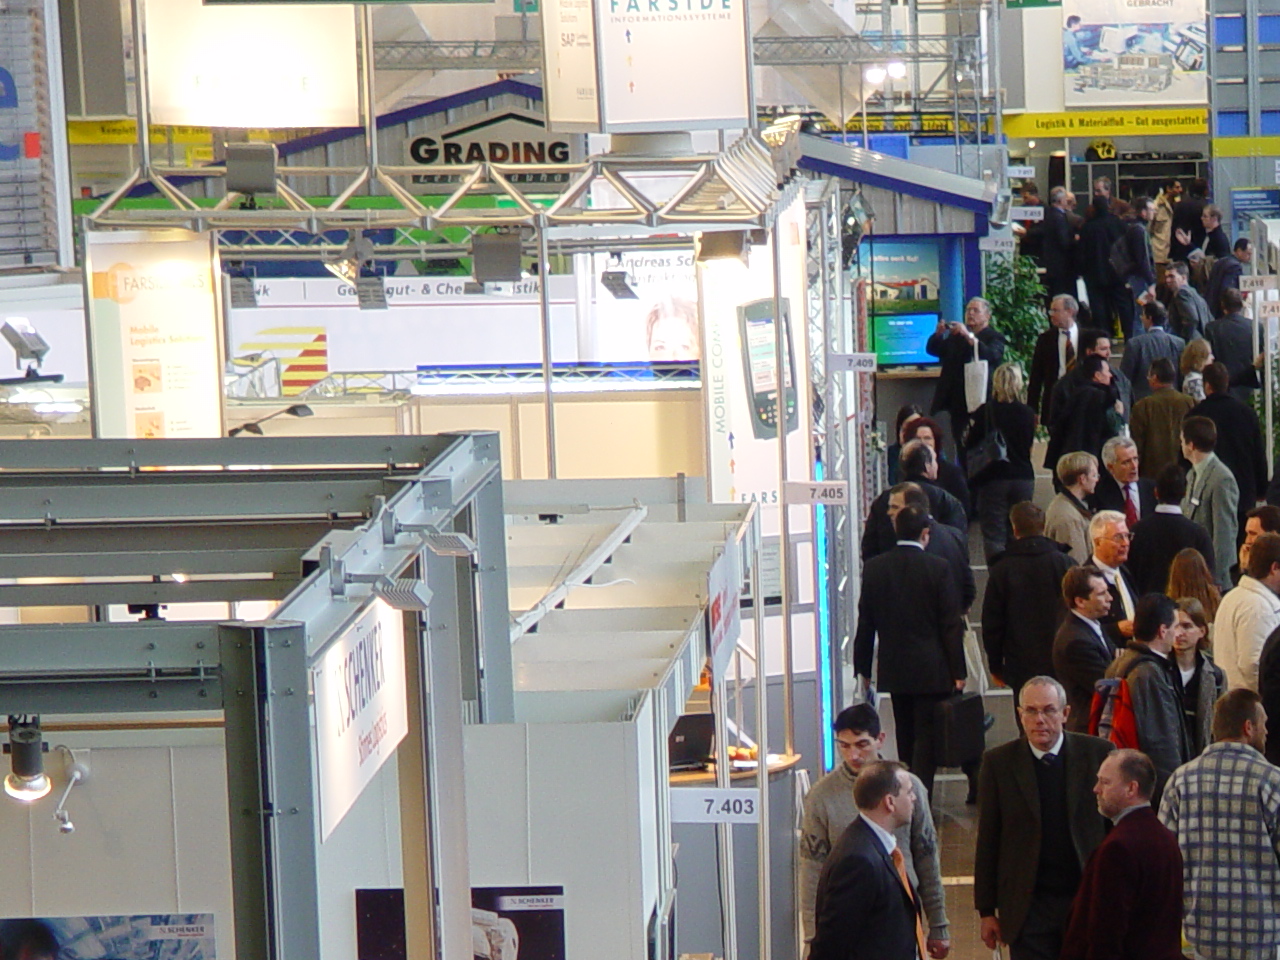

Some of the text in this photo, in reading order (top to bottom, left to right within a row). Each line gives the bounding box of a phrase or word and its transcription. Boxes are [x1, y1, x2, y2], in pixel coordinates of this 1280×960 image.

[610, 0, 731, 13] FARSIDE
[610, 13, 731, 24] INFORMATIONSSYSTEME
[1036, 118, 1066, 129] Logistik
[1078, 117, 1125, 128] Materialfluß
[1136, 116, 1149, 126] Gut
[1151, 115, 1200, 127] ausgestattet
[410, 137, 570, 165] GRADING
[421, 283, 430, 295] &
[847, 358, 874, 368] 7.409
[712, 375, 726, 434] MOBILE
[809, 487, 844, 499] 7.405
[344, 620, 386, 729] SCHENKER
[703, 798, 756, 814] 7.403
